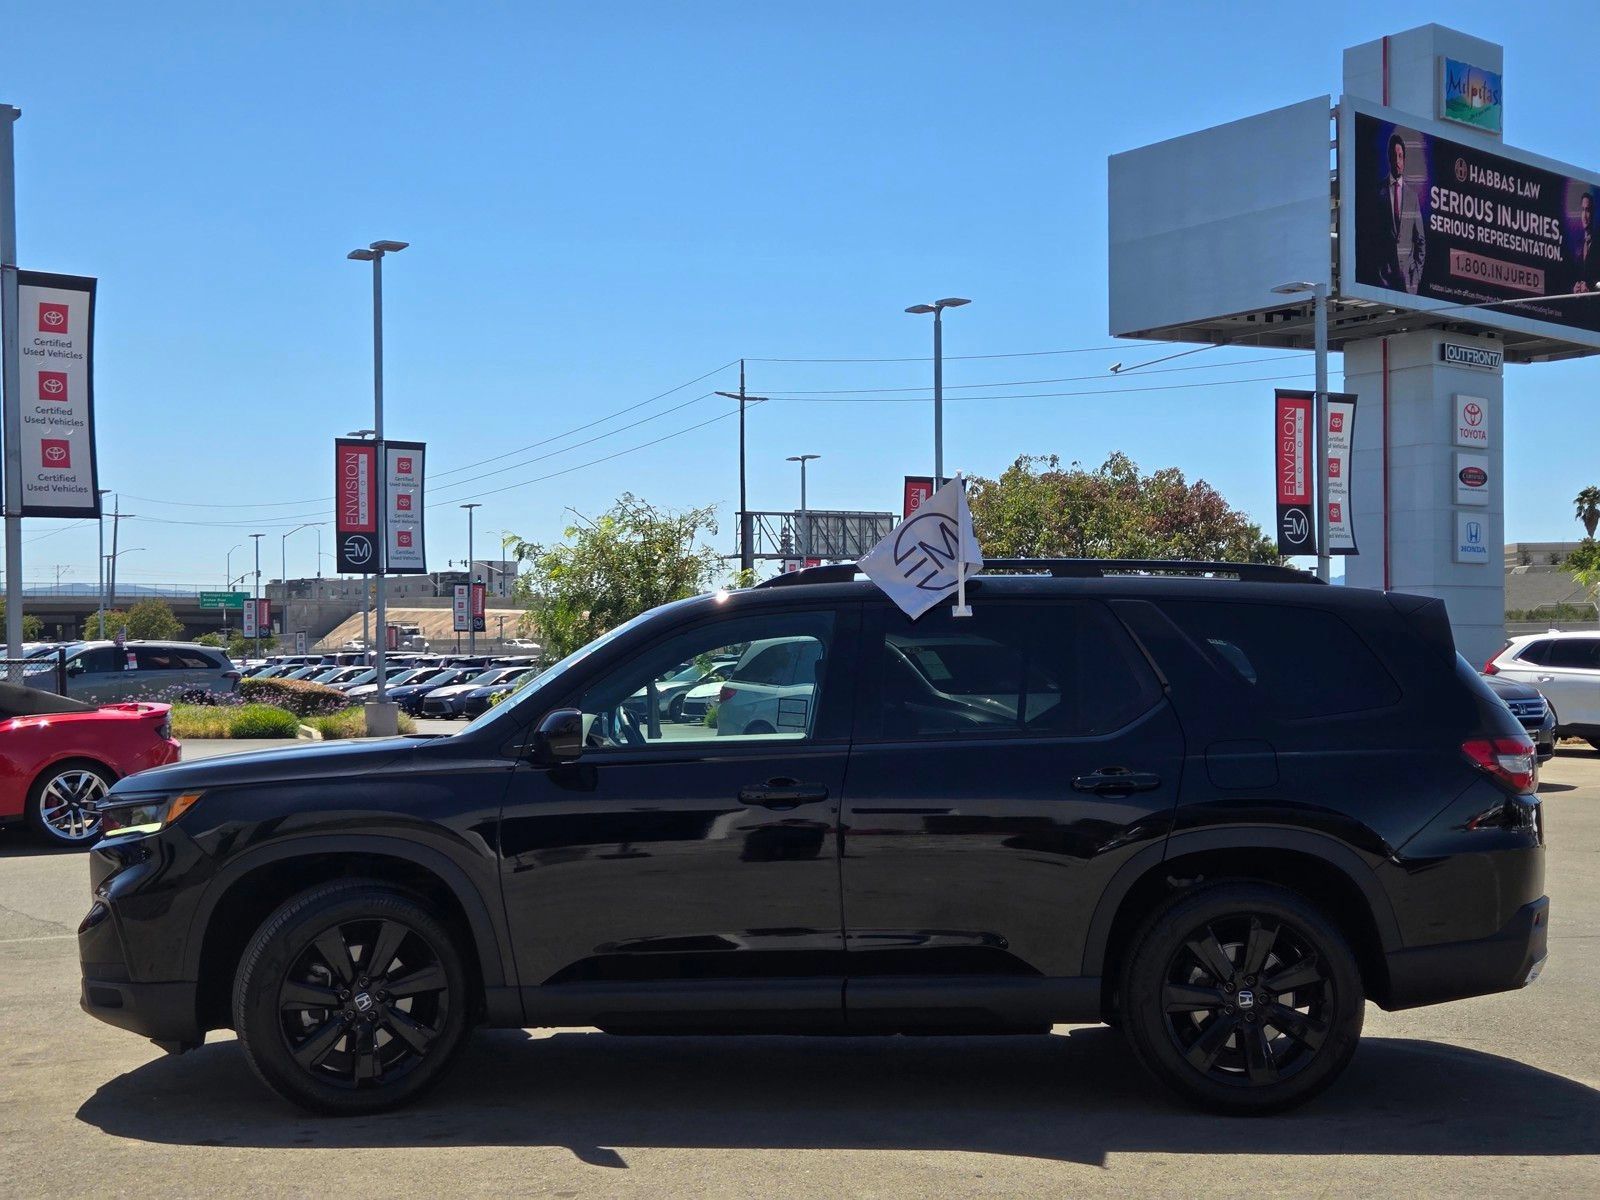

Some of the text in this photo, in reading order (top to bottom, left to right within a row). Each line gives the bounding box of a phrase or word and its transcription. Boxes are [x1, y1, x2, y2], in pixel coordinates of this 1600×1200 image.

[1447, 69, 1498, 109] Milpitas
[1469, 164, 1540, 199] HABBAS LAW
[1430, 185, 1563, 244] SERIOUS INJURIES,
[1430, 213, 1563, 261] SERIOUS REPRESENTATION.
[1456, 255, 1540, 288] 1.800.INJURED
[23, 347, 83, 360] Used Vehicles
[34, 337, 72, 348] Certified
[24, 416, 84, 427] Used Vehicles
[35, 406, 73, 416] Certified
[1460, 428, 1487, 440] TOYOTA
[1284, 407, 1296, 496] ENVISION
[27, 483, 88, 493] Used Vehicles
[38, 473, 76, 483] Certified
[345, 453, 359, 526] ENVISION
